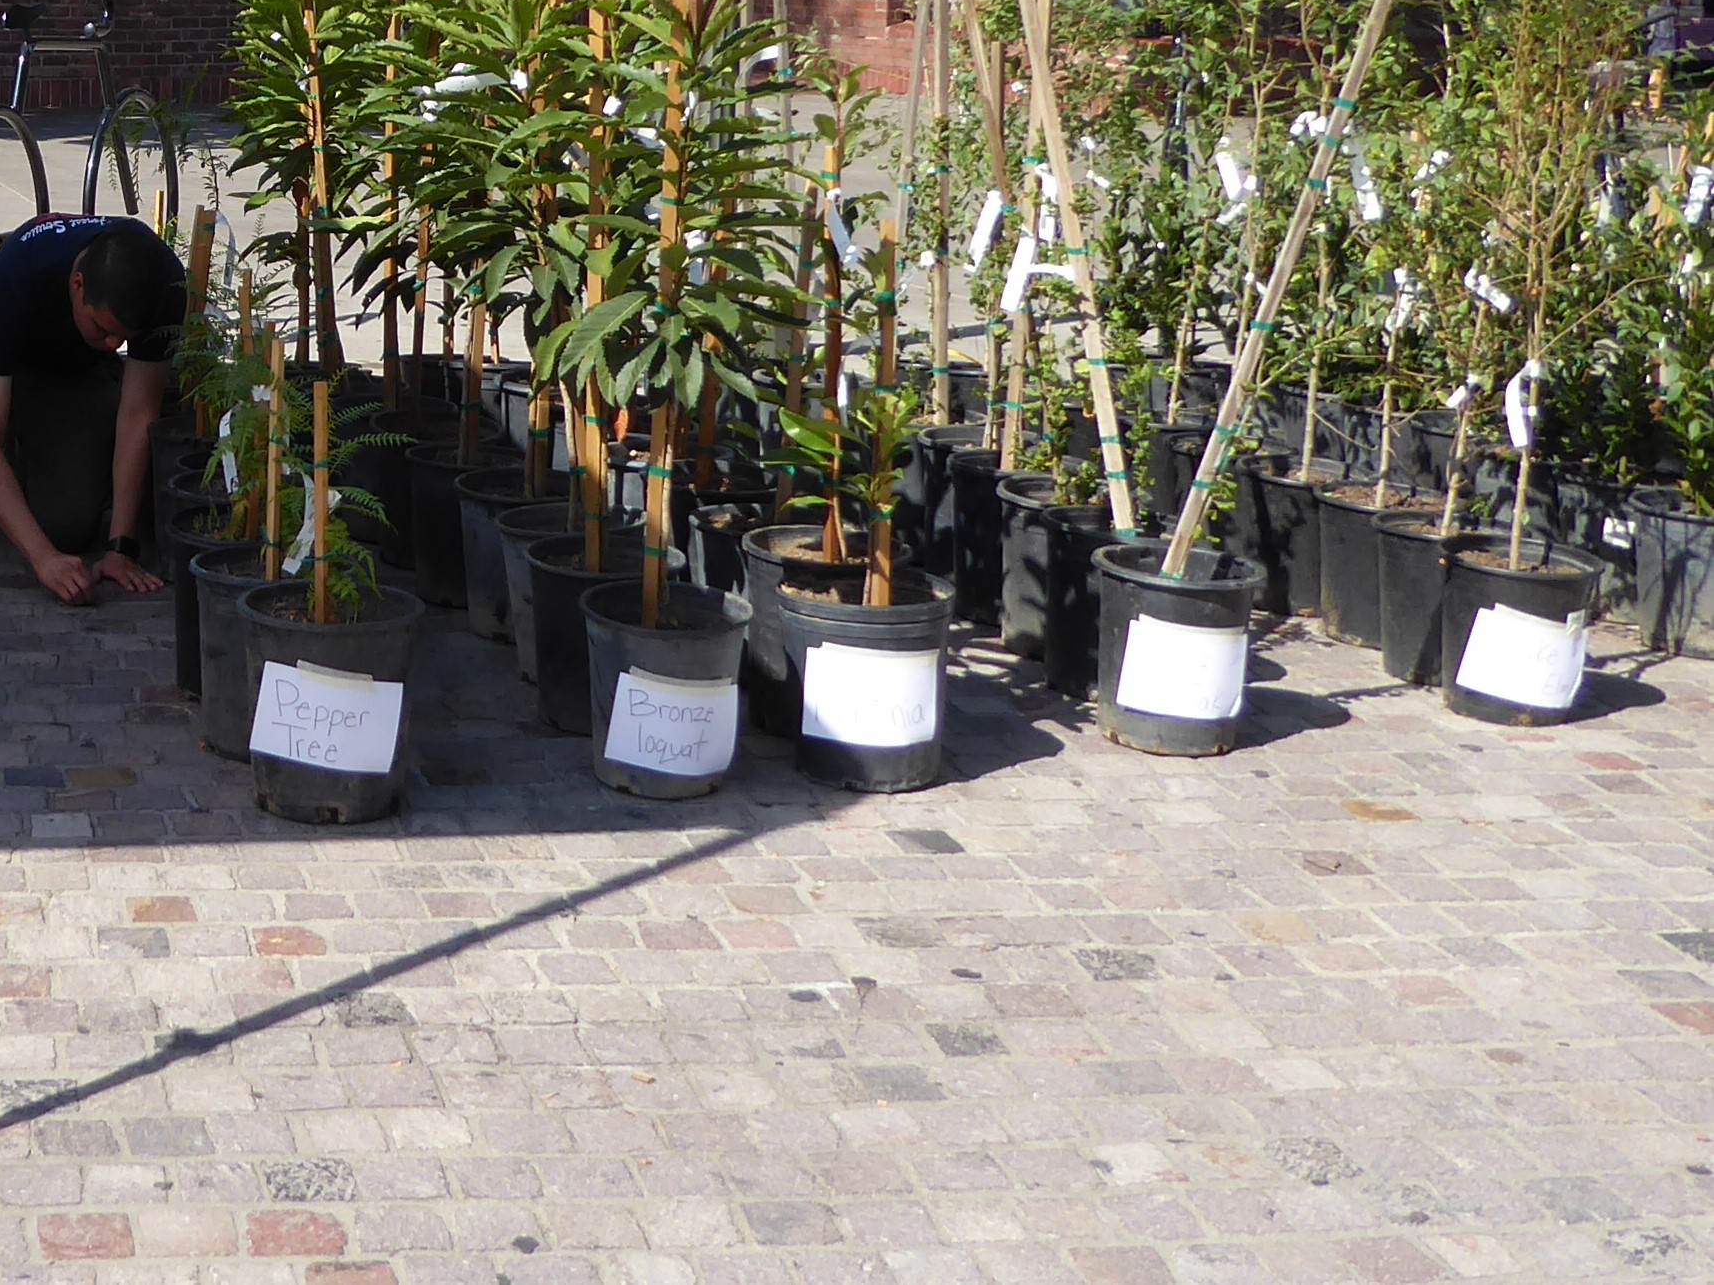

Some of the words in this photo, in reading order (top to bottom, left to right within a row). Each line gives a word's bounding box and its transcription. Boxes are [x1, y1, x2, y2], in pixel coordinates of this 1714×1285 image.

[274, 679, 371, 740] Pepper
[627, 688, 716, 724] Bronze
[271, 721, 339, 764] Tree
